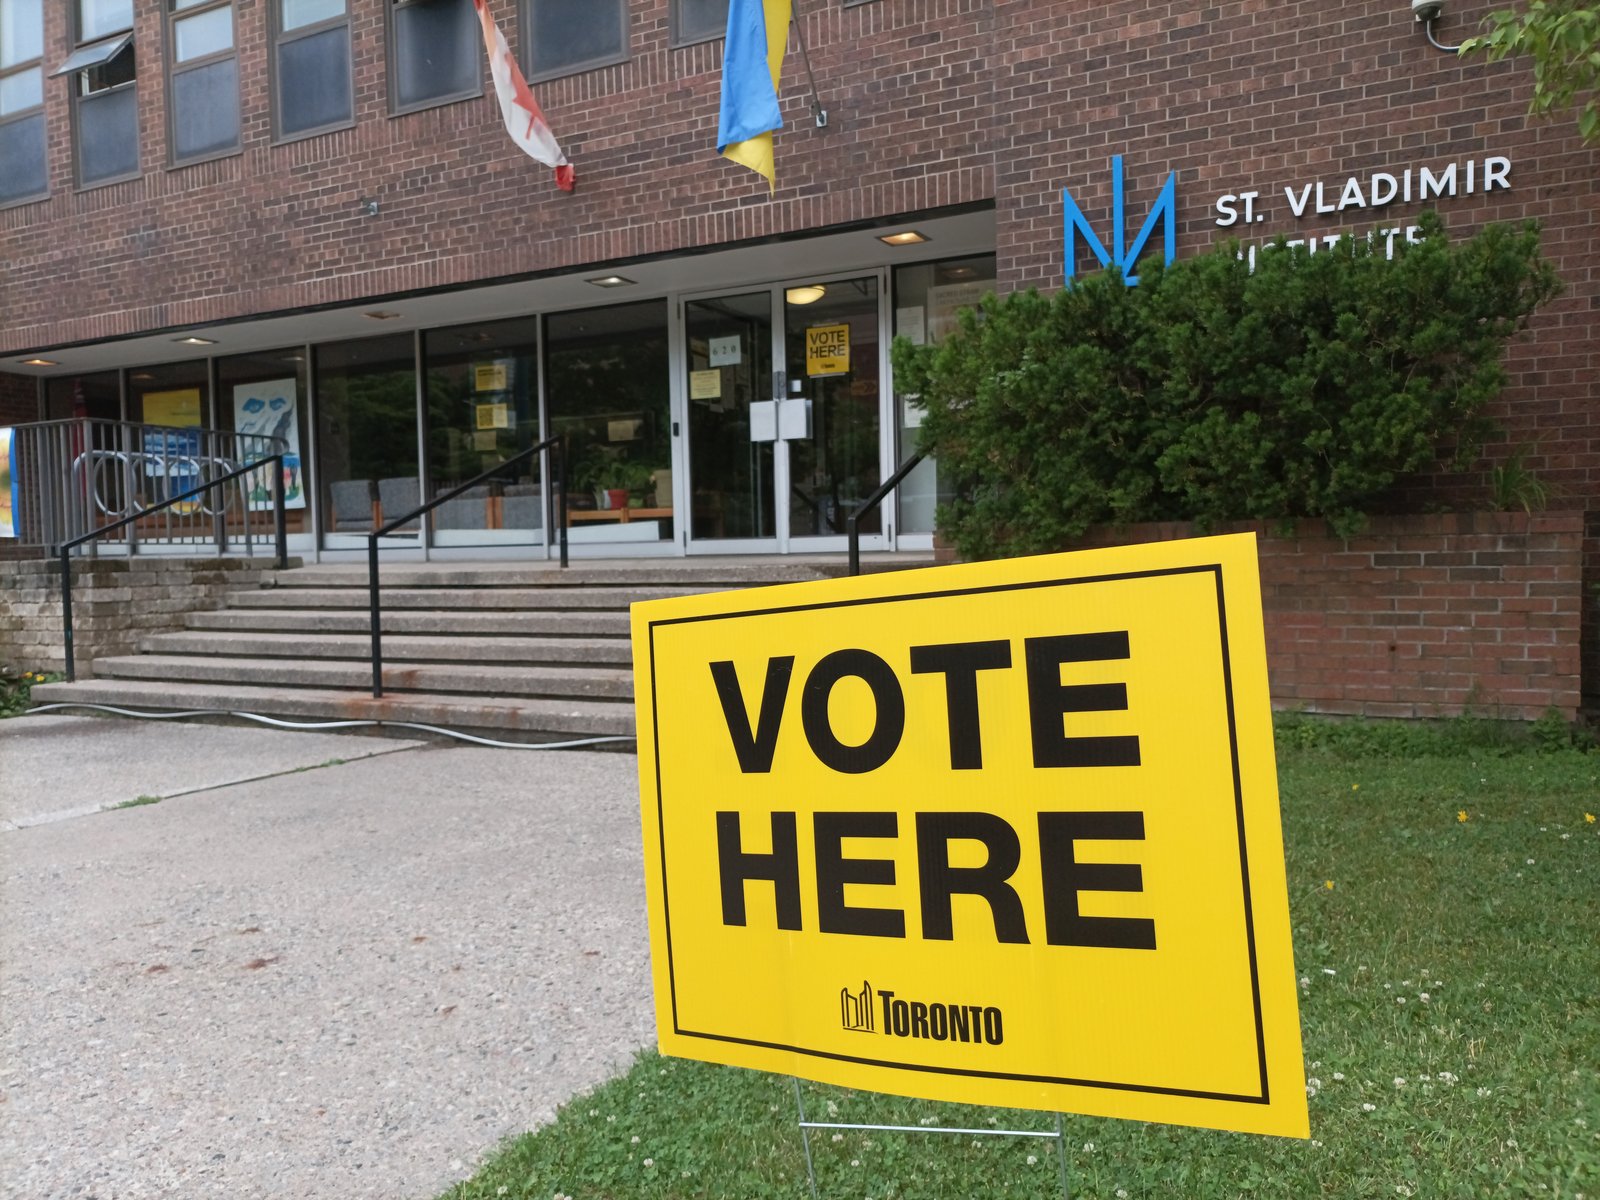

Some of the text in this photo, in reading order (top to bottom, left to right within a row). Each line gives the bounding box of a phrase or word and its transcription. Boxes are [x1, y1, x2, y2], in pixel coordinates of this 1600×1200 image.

[1215, 156, 1511, 227] ST. VLADIMIR
[810, 330, 846, 345] VOTE
[810, 344, 846, 359] HERE
[709, 631, 1142, 774] VOTE
[716, 811, 1157, 950] HERE
